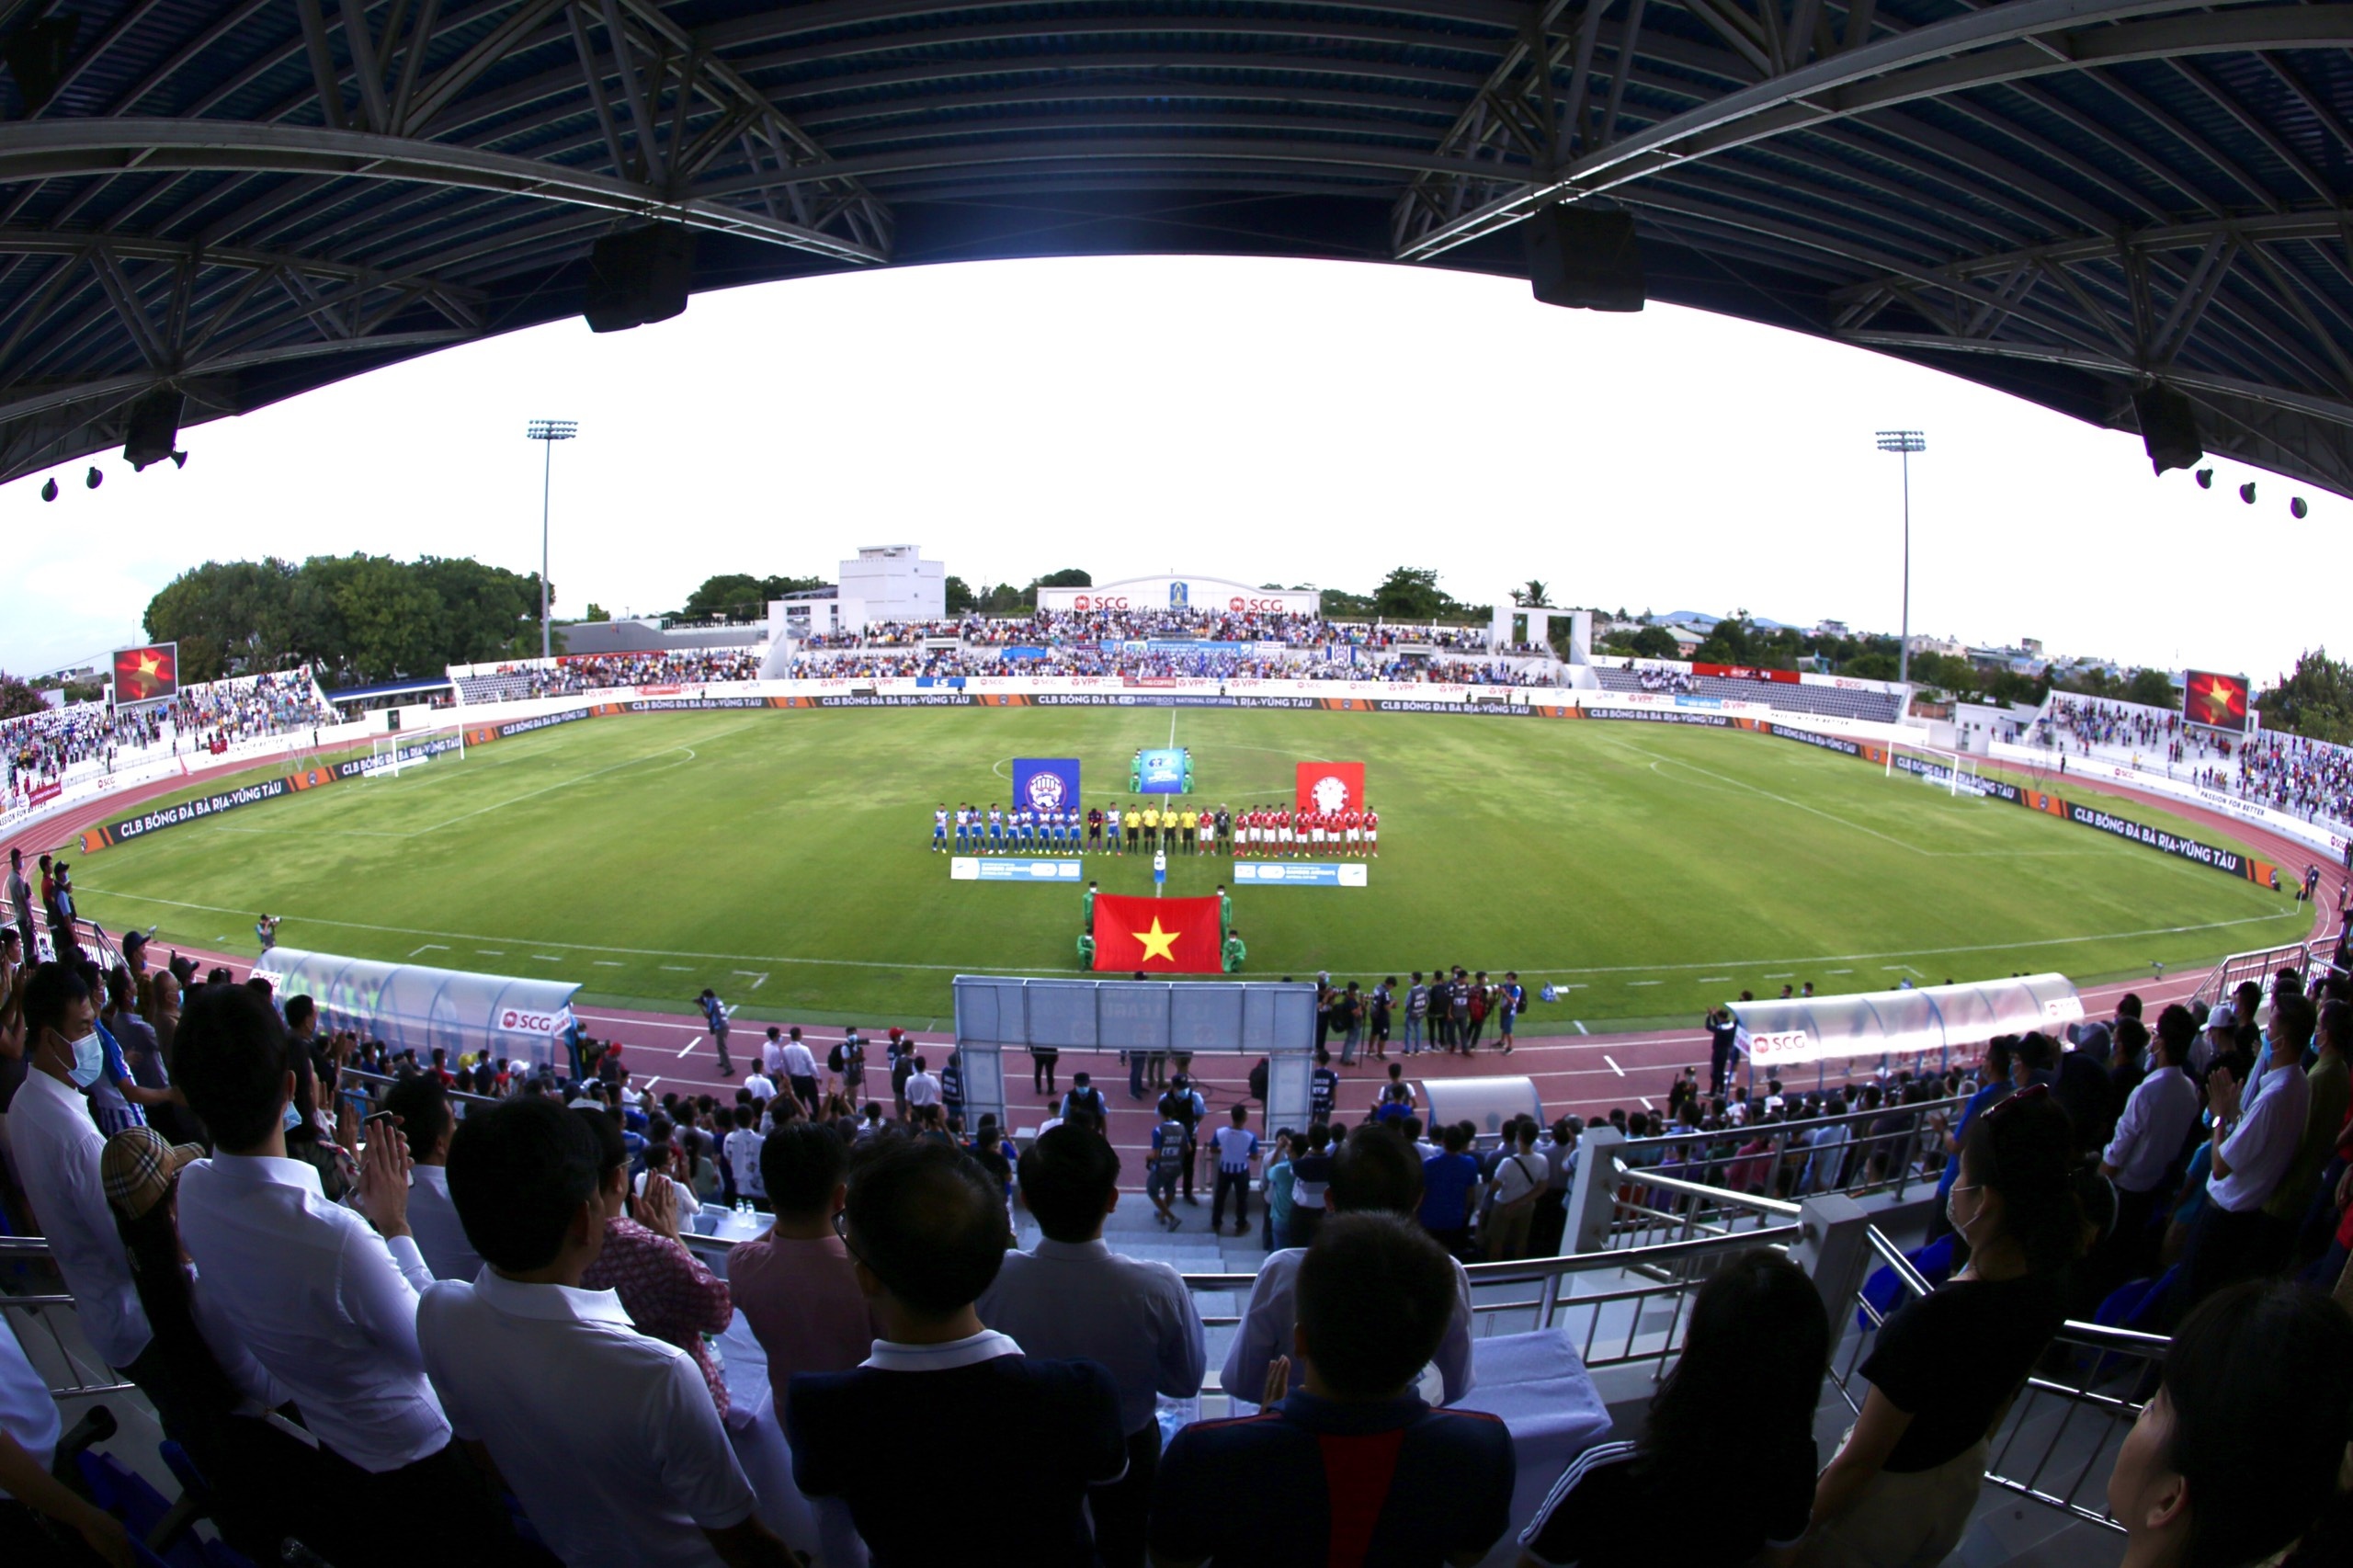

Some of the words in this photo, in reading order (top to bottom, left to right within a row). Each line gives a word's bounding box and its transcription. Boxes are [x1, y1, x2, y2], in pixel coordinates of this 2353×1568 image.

[1095, 597, 1128, 609] SCG
[1250, 599, 1283, 612] SCG
[933, 679, 949, 687] LS
[1080, 677, 1100, 687] VPF
[1242, 679, 1260, 687] VPF
[1448, 685, 1466, 693] VPF
[1497, 687, 1515, 695] VPF
[822, 697, 840, 706] CLB
[842, 695, 869, 706] BÓNG
[949, 694, 970, 704] TÀU
[1038, 695, 1058, 704] CLB
[1060, 694, 1090, 704] BÓNG
[1241, 696, 1290, 708] RỊA-VŨNG
[1291, 696, 1313, 708] TÀU
[1637, 695, 1654, 703] VPF
[1381, 701, 1402, 710] CLB
[1403, 699, 1431, 711] BÓNG
[1433, 700, 1448, 712] ĐÁ
[1449, 700, 1461, 713] BÀ
[1511, 703, 1530, 715] TÀU
[1590, 709, 1608, 718] CLB
[1609, 708, 1635, 719] BÓNG
[1708, 713, 1726, 725] TÀU
[342, 764, 360, 776] CLB
[446, 736, 460, 749] TÀU
[1897, 756, 1912, 769] CLB
[1996, 784, 2015, 799] TÀU
[2121, 770, 2134, 778] SCG
[103, 777, 115, 787] SCG
[120, 820, 143, 837] CLB
[144, 810, 177, 830] BÓNG
[179, 801, 195, 821] ĐÁ
[196, 797, 211, 815] BÀ
[212, 787, 261, 812] RỊA-VŨNG
[262, 779, 282, 798] TÀU
[2200, 790, 2227, 804] PASSION
[2229, 798, 2242, 809] FOR
[2243, 803, 2265, 817] BETTER
[2074, 807, 2095, 824] CLB
[2095, 810, 2125, 834] BÓNG
[2125, 824, 2140, 840] ĐÁ
[2142, 827, 2157, 846] BÀ
[2158, 833, 2211, 862] RỊA-VŨNG
[2212, 849, 2236, 870] TÀU
[518, 1014, 551, 1031] SCG
[1773, 1035, 1805, 1051] SCG
